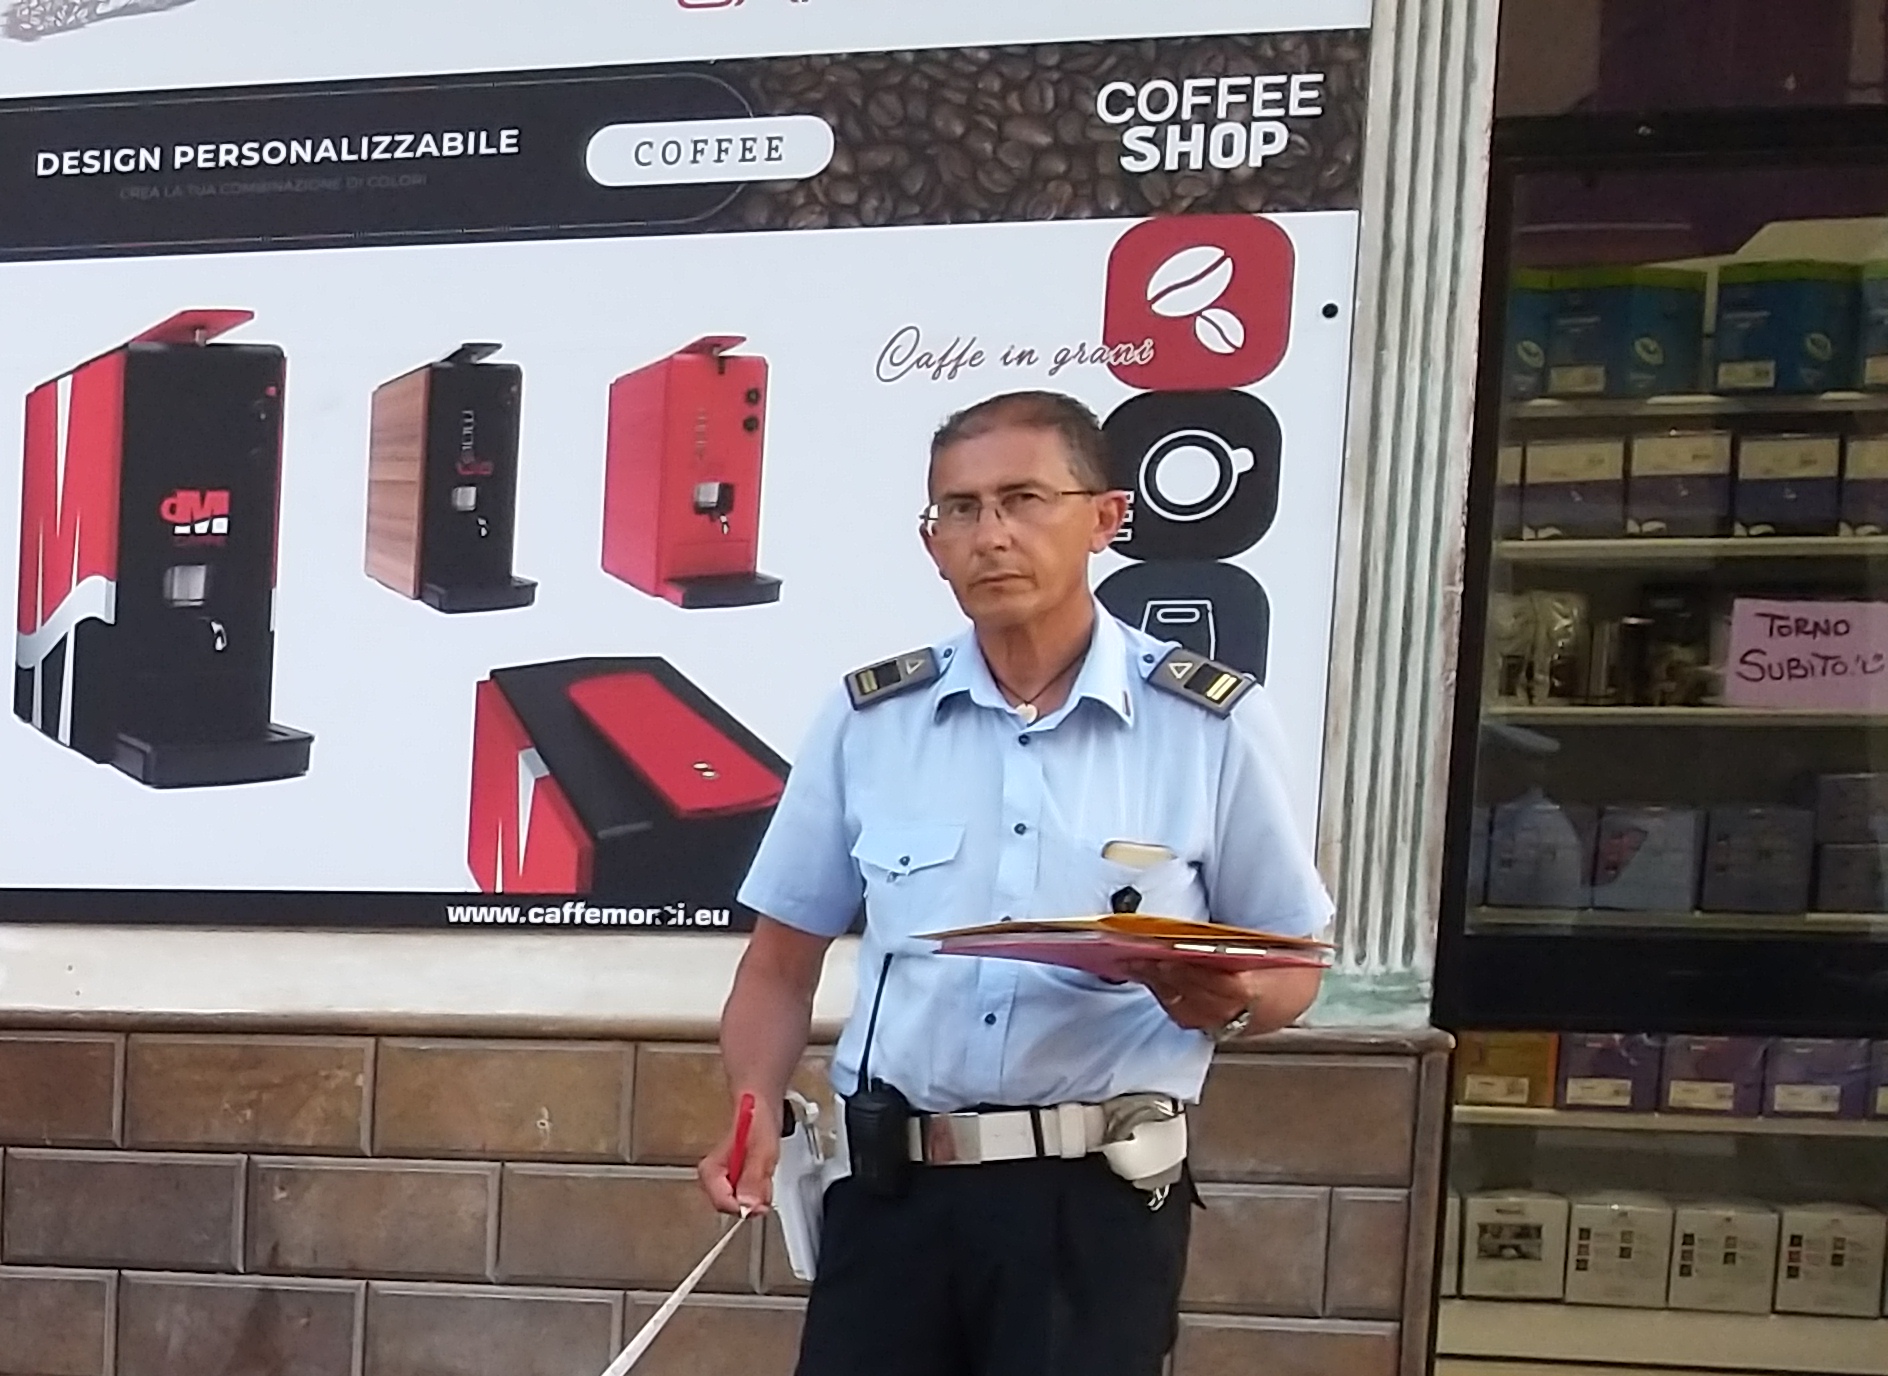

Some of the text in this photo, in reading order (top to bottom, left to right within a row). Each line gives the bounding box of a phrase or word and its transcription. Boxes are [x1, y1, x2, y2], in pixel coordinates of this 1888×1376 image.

[1096, 73, 1325, 124] COFFEE
[36, 128, 520, 177] DESIGN PERSONALIZZABILE
[634, 136, 783, 167] COFFEE
[1120, 121, 1289, 173] SHOP
[1000, 344, 1039, 367] in
[1048, 338, 1156, 377] grani
[1754, 612, 1851, 639] TORNO
